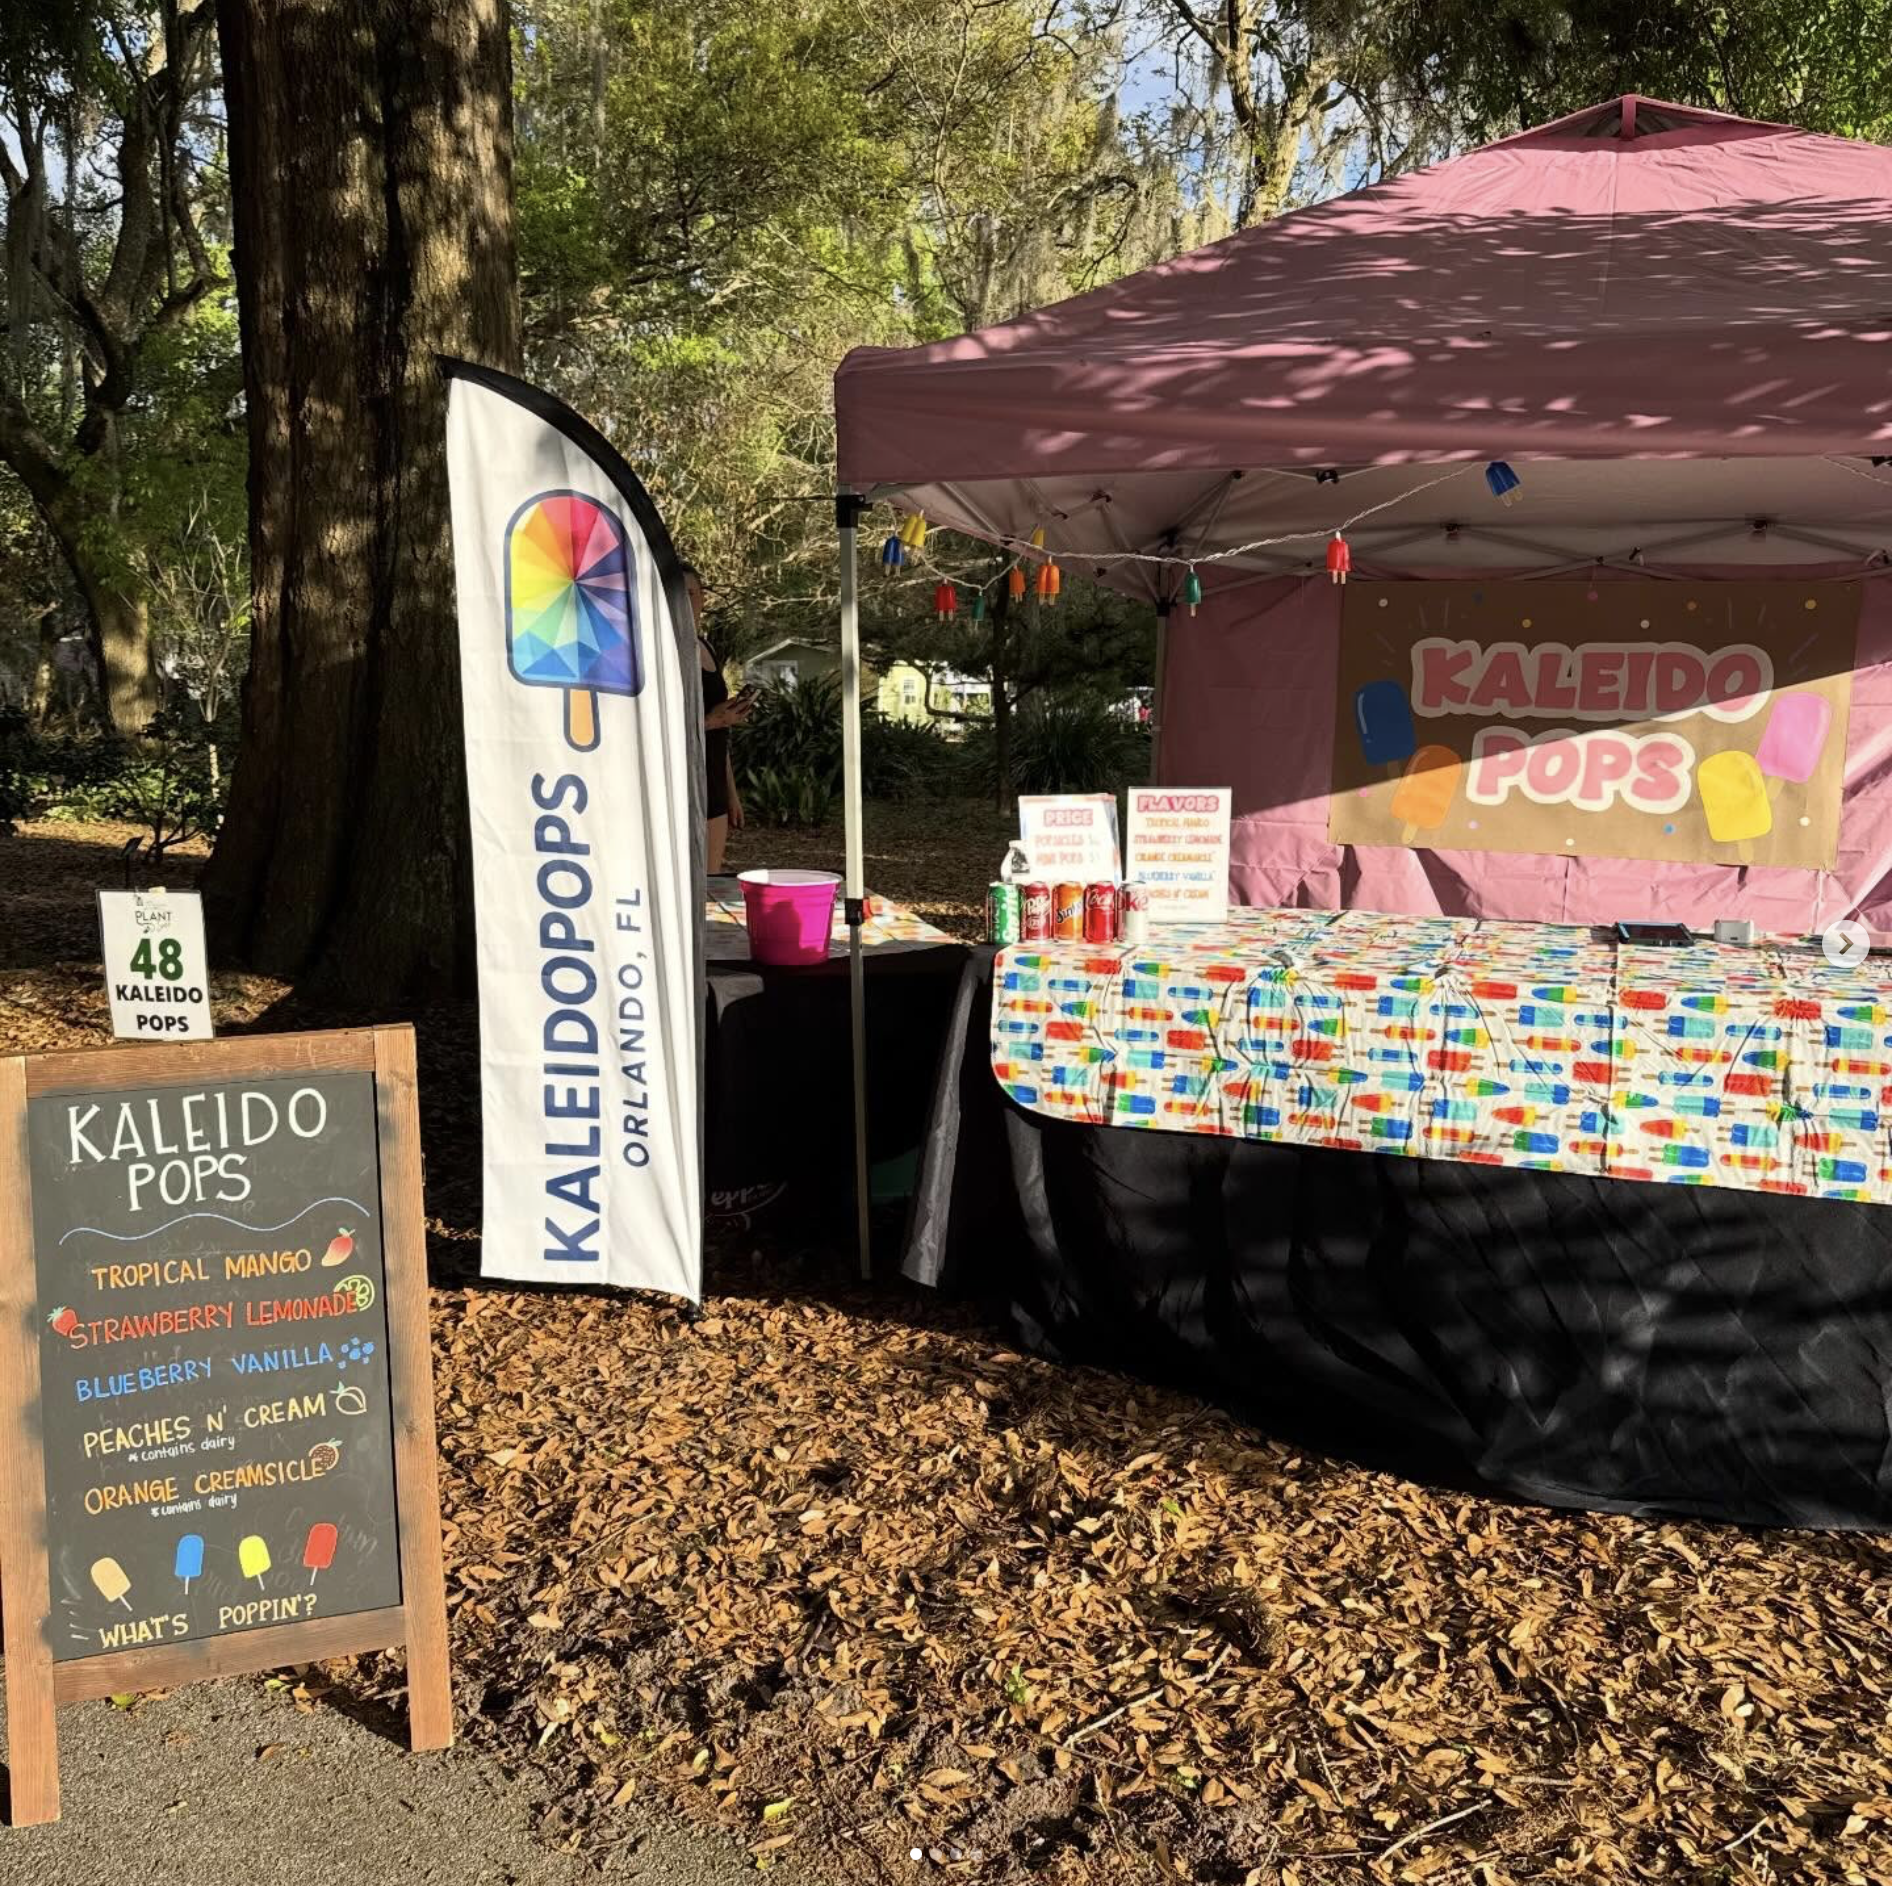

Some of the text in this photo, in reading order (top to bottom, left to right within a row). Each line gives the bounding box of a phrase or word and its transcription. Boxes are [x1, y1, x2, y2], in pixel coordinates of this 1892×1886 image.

[1417, 641, 1768, 718] KALEIDO
[1472, 731, 1689, 807] POPS
[1044, 809, 1093, 827] PRICE
[1137, 795, 1219, 813] FLAVORS
[135, 911, 172, 922] PLANT
[130, 938, 184, 981] 48
[116, 984, 203, 1003] KALEIDO
[531, 773, 601, 1263] KALEIDOPOPS
[136, 1014, 189, 1032] POPS
[616, 888, 649, 1167] ORLANDO, FL
[68, 1087, 327, 1164] KALEIDO
[128, 1153, 251, 1211] POPS
[91, 1248, 312, 1291] TROPICAL MANGO
[69, 1290, 358, 1349] STRAWBERRY LEMONADE
[76, 1343, 334, 1402] BLUEBERRY VANILLA
[83, 1393, 327, 1458] PEACHES N' CREAM
[201, 1434, 235, 1451] dairy
[84, 1457, 326, 1515] ORANGE CREAMSICLE
[208, 1493, 238, 1509] dairy
[99, 1593, 318, 1649] WHAT'S POPPIN'?
